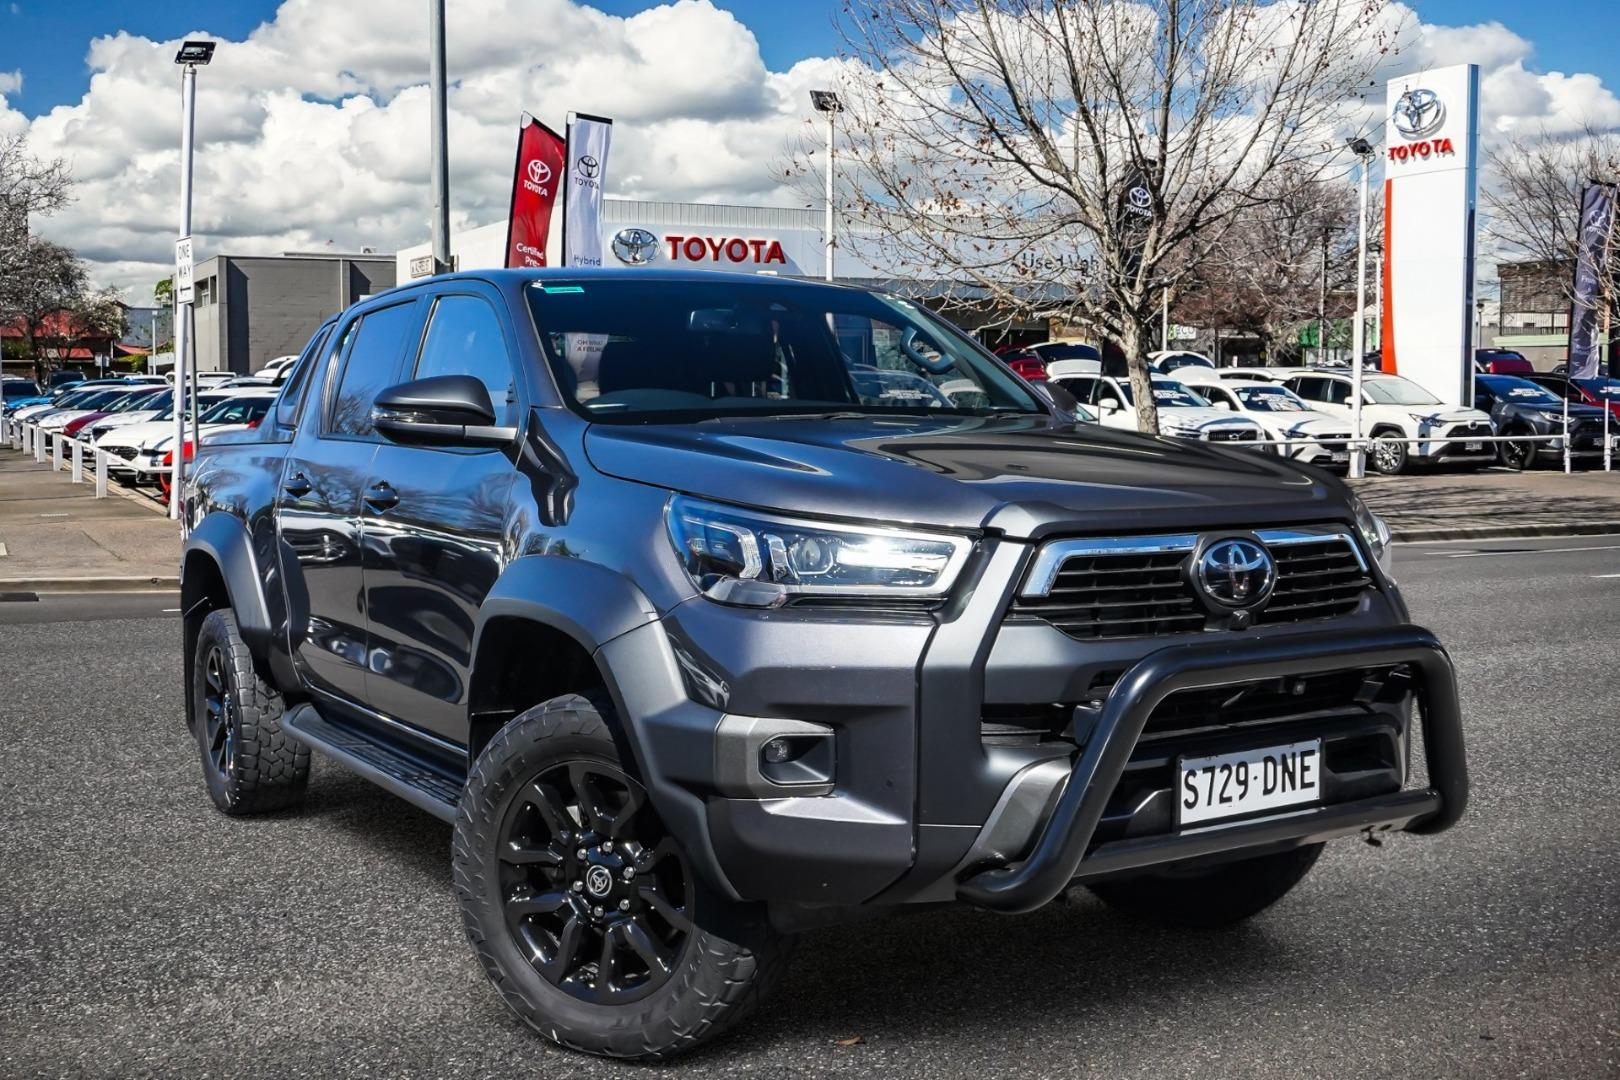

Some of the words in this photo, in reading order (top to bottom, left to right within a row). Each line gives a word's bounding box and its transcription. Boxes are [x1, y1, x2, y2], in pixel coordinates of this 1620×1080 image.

[1387, 138, 1455, 161] TOYOTA
[523, 180, 548, 197] TOYOTA
[574, 177, 600, 190] TOYOTA
[178, 244, 190, 260] ONE
[665, 236, 787, 264] TOYOTA
[573, 254, 602, 266] Hybrid
[178, 264, 191, 279] WAY
